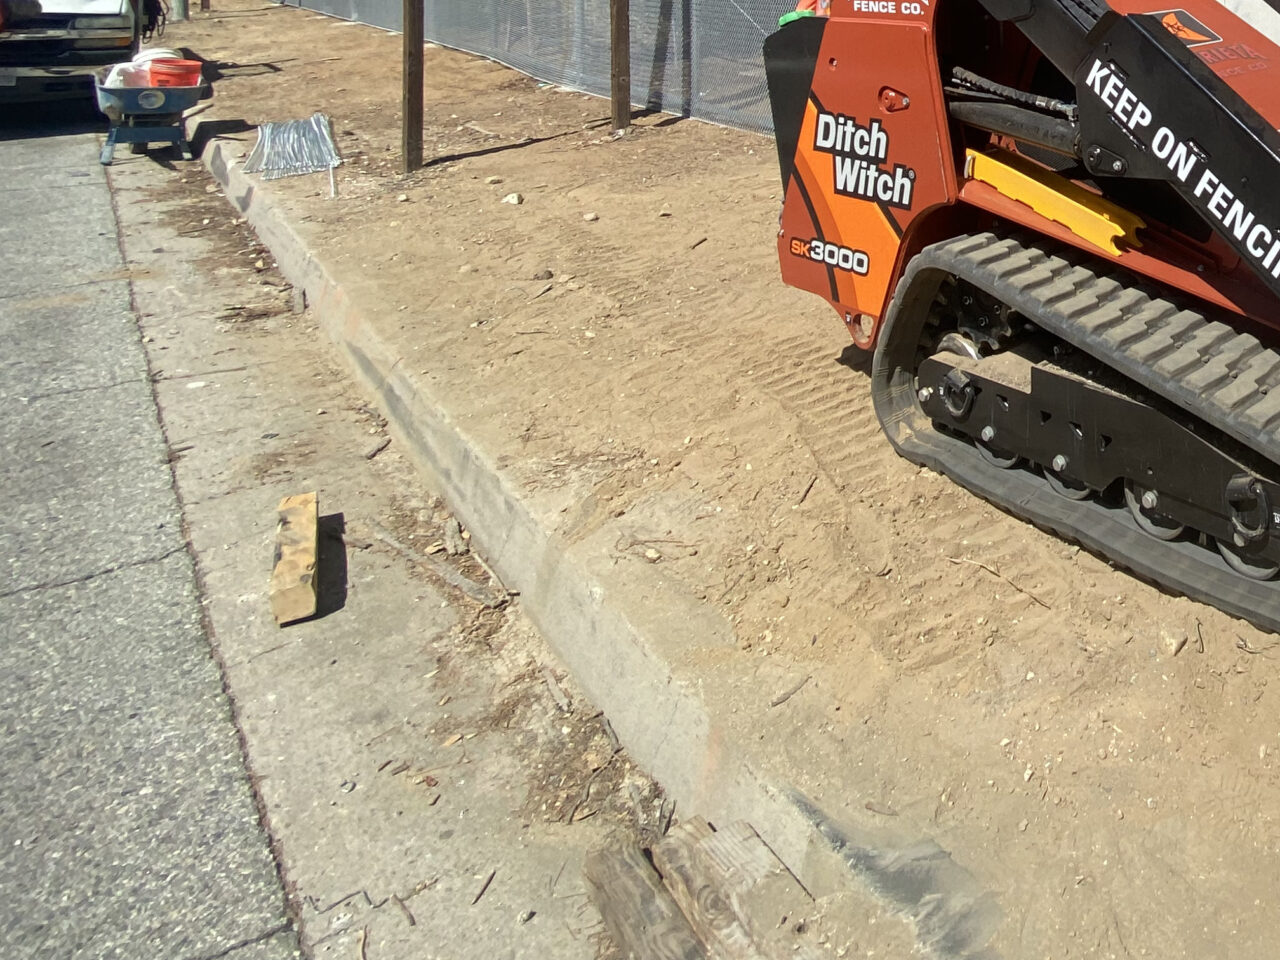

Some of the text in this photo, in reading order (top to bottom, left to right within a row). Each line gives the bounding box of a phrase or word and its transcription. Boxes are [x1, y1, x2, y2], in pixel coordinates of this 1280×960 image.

[853, 0, 924, 15] FENCE CO.
[1195, 44, 1268, 64] RIETA
[815, 113, 887, 159] Ditch
[1085, 58, 1152, 131] KEEP
[1151, 126, 1198, 183] ON
[835, 156, 912, 205] Witch
[791, 240, 868, 273] SK3000
